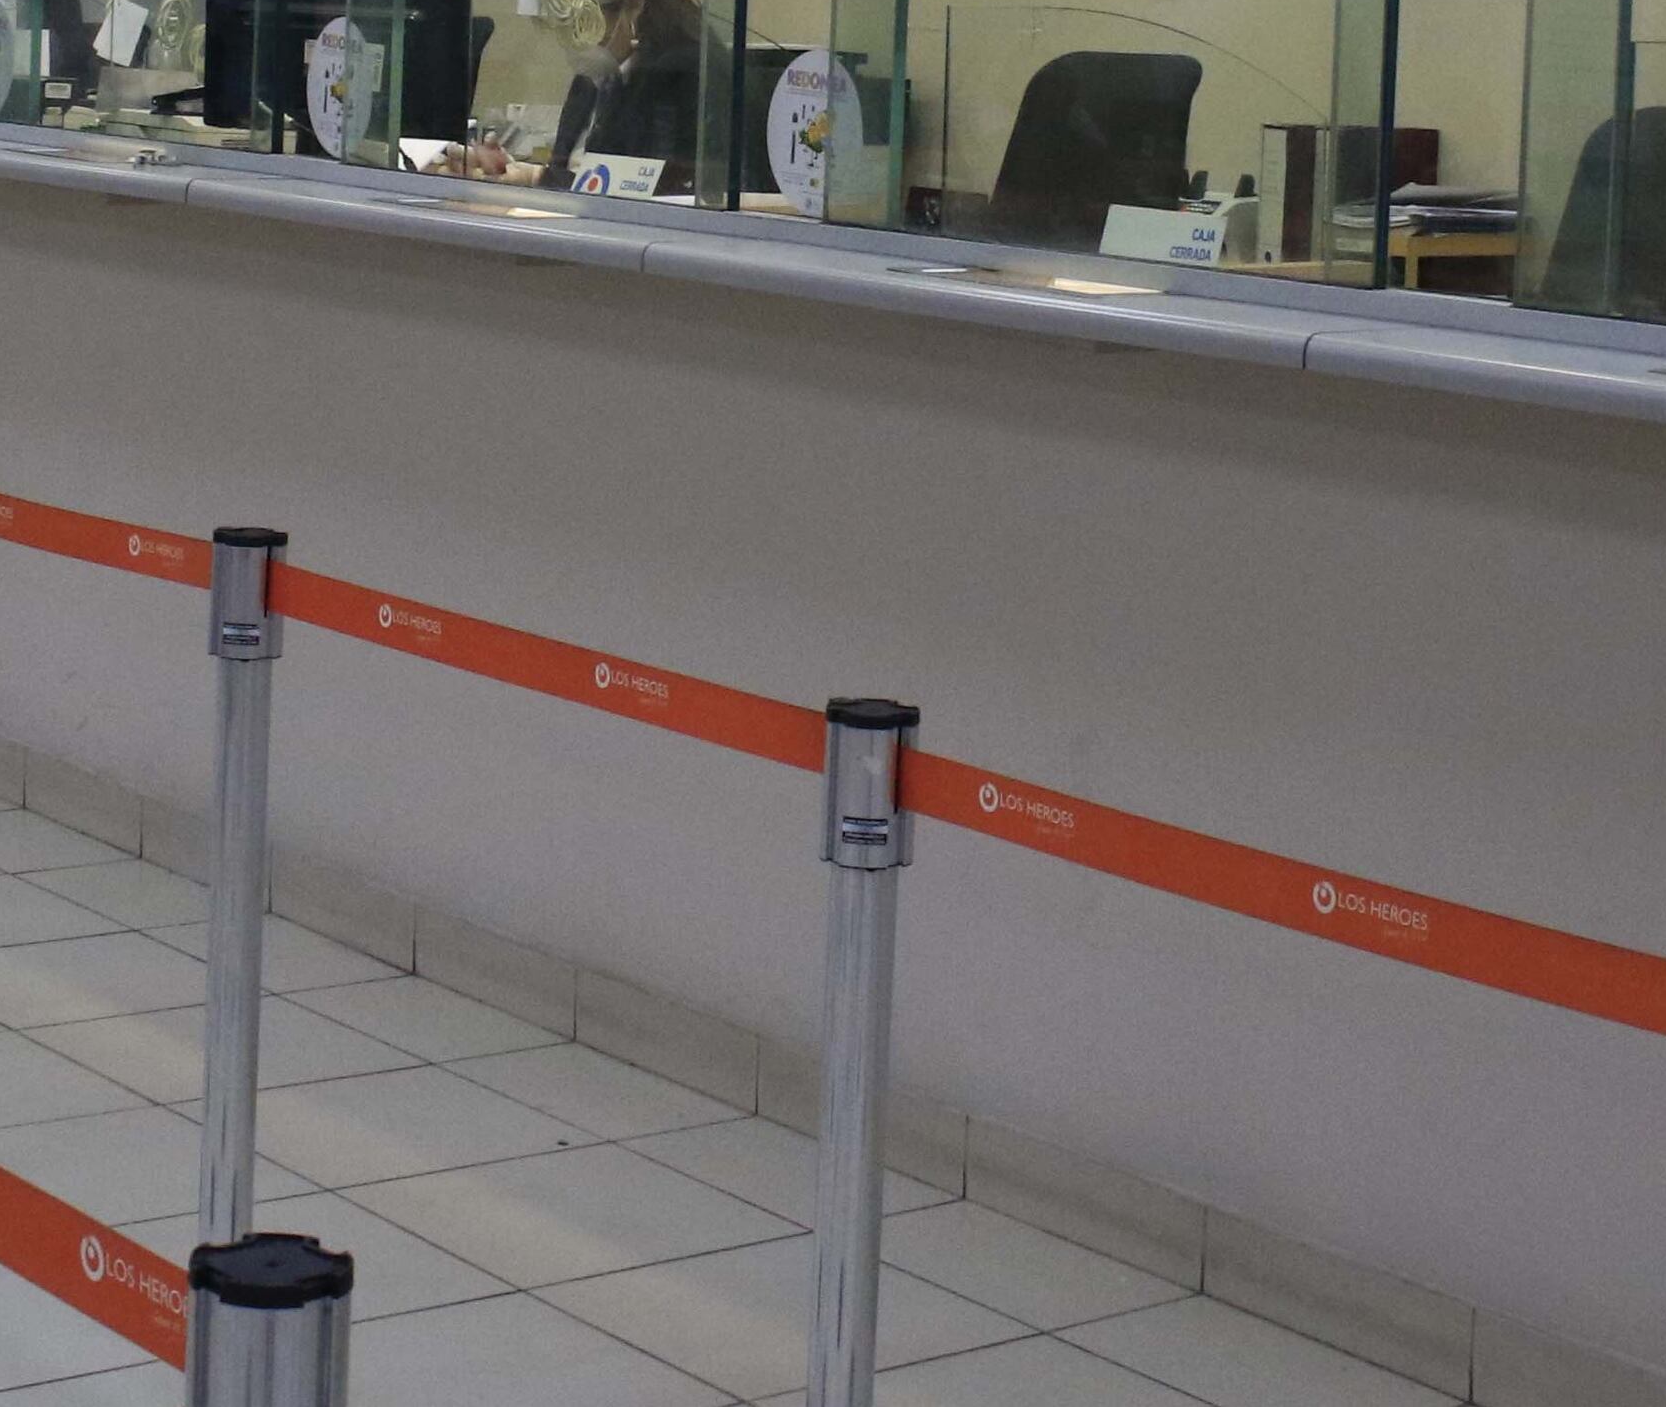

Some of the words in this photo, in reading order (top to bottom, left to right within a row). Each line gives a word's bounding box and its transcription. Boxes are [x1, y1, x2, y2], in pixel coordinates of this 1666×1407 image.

[1192, 228, 1215, 242] CAJA
[1169, 246, 1212, 261] CERRADA
[393, 611, 408, 626] LOS
[611, 670, 629, 687] LOS
[631, 675, 669, 699] HEROES
[1000, 793, 1023, 812] LOS
[1027, 800, 1075, 828] HEROES
[1337, 894, 1366, 914] LOS
[1370, 901, 1429, 930] HEROES
[105, 1252, 135, 1289] LOS
[139, 1270, 188, 1318] HERO
